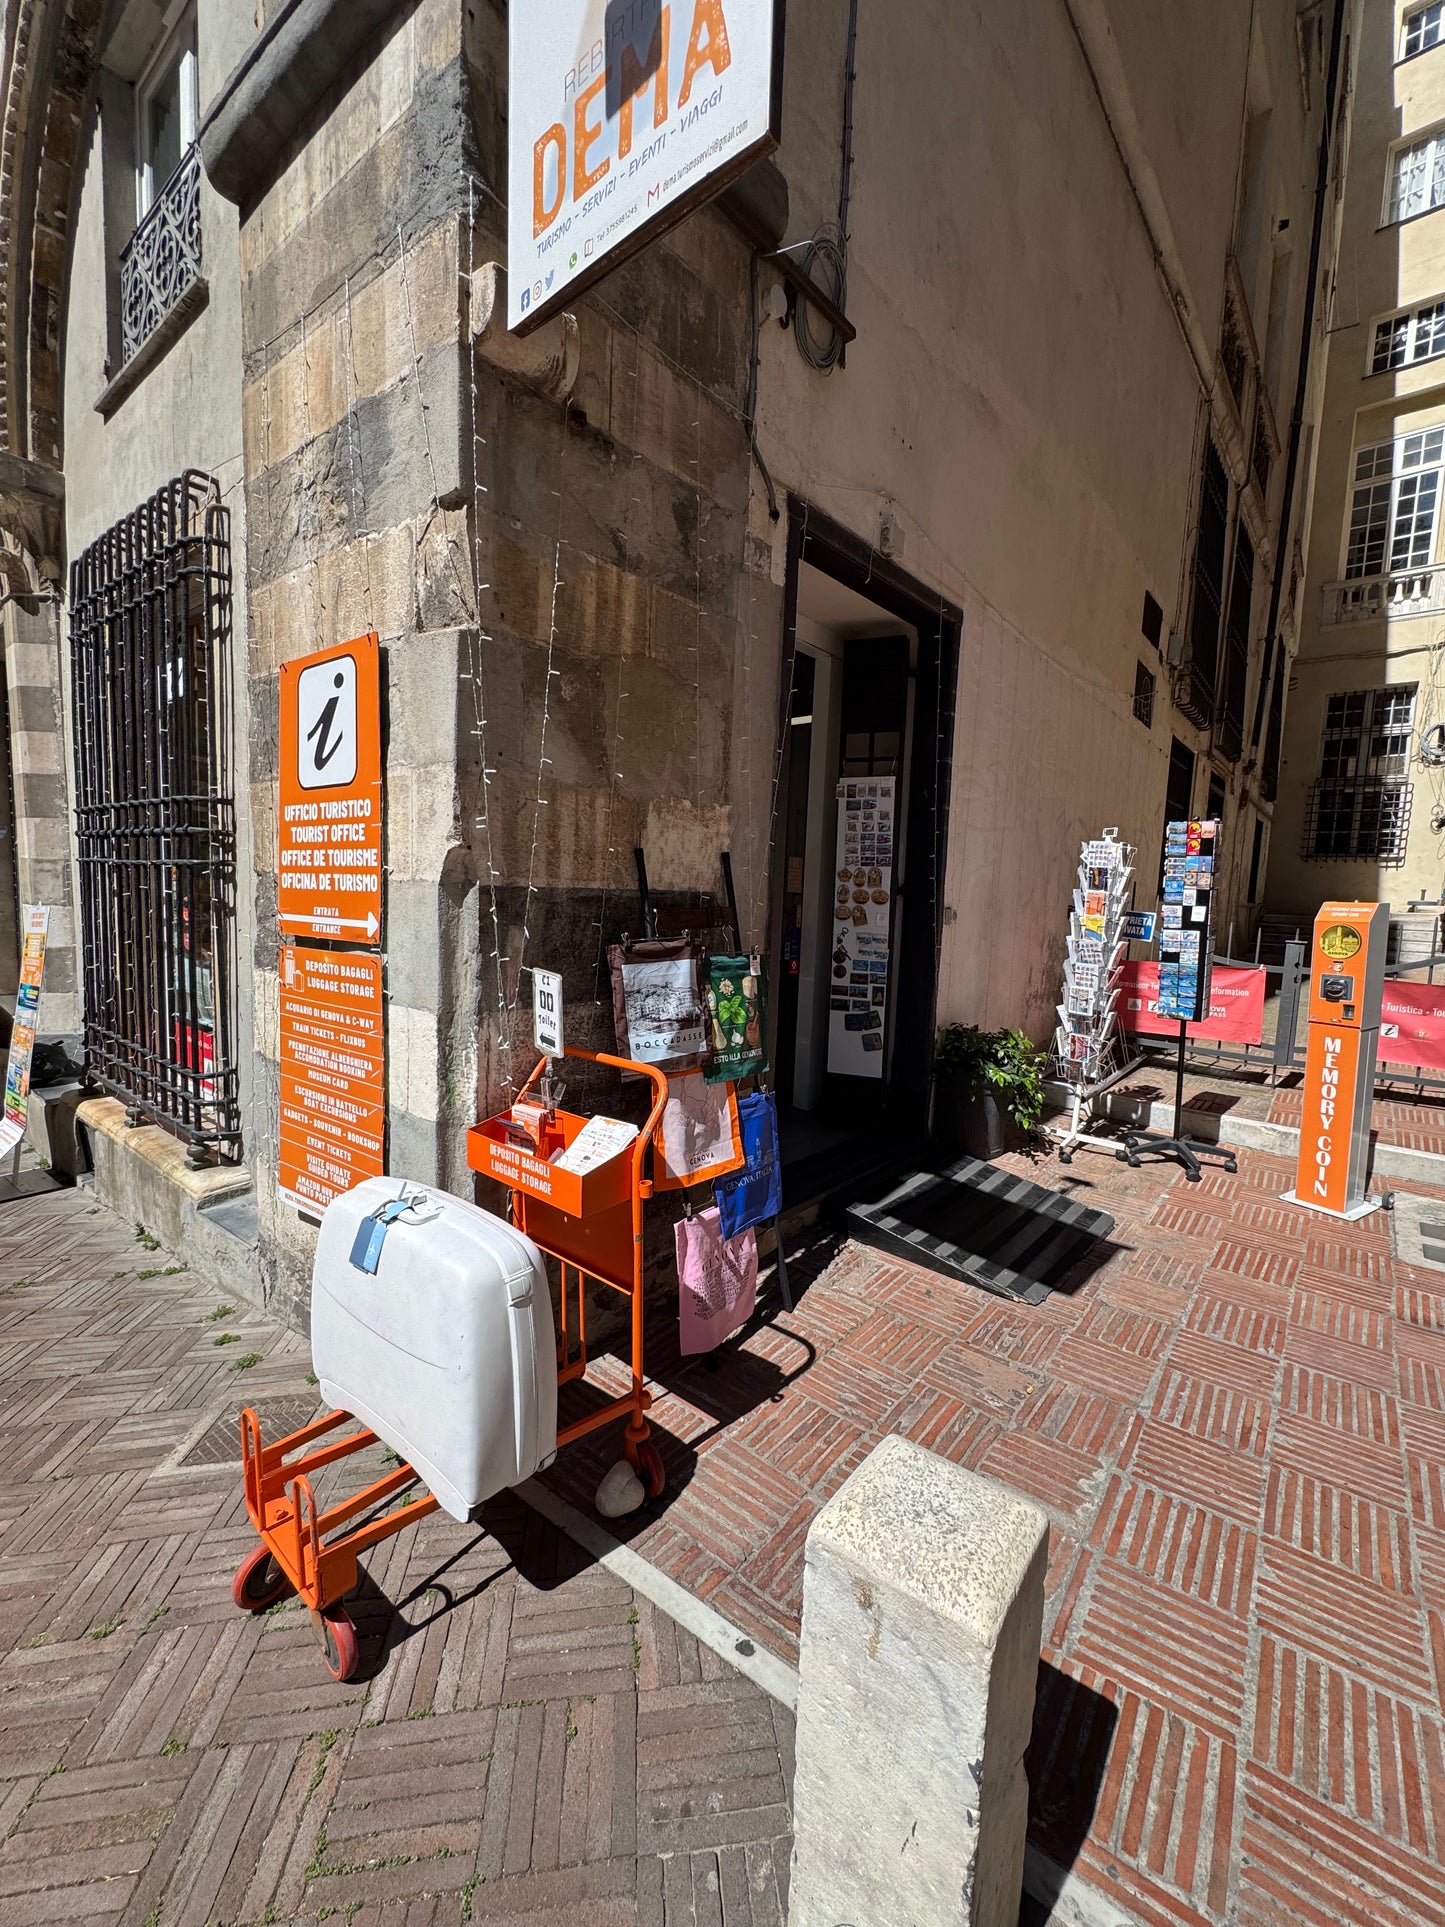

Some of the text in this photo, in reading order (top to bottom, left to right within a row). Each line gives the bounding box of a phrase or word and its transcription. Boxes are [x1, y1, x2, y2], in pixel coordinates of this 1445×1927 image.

[532, 0, 732, 241] DEMA
[536, 217, 572, 258] TURISMO
[582, 176, 617, 218] SERVIZI
[628, 133, 666, 178] EVENTI
[680, 85, 723, 133] VIAGGI
[284, 798, 372, 822] UFFICIO TURISTICO
[291, 823, 366, 843] TOURIST OFFICE
[281, 848, 379, 867] OFFICE DE TOURISME
[281, 872, 378, 893] OFICINA DE TURISMO
[313, 906, 340, 917] ENTRATA
[312, 923, 342, 935] ENTRANCE
[1123, 926, 1145, 936] IVATA
[305, 960, 374, 981] DEPOSITO BAGAGLI
[307, 976, 375, 999] LUGGAGE STORAGE
[1210, 987, 1250, 997] nformation
[285, 1001, 312, 1016] ACQUARIO
[313, 1007, 320, 1017] DI
[321, 1008, 345, 1023] GENOVA
[352, 1016, 374, 1029] C-WAY
[1386, 1002, 1423, 1015] Turistica
[538, 1014, 556, 1031] Toilet
[292, 1021, 309, 1033] TRAIN
[310, 1026, 335, 1040] TICKETS
[340, 1033, 366, 1048] FLIXBUS
[635, 1031, 703, 1051] BOCCADASSE
[288, 1039, 373, 1071] PRENOTAZIONE ALBERGHIERA
[713, 1054, 729, 1064] ESTO
[307, 1069, 349, 1090] MUSEUM CARD
[339, 1062, 366, 1079] BOOKING
[1318, 1036, 1342, 1131] MEMORY
[294, 1085, 368, 1118] ESCURSIONI IN BATTELLO
[303, 1097, 357, 1124] BOAT EXCURSIONS
[283, 1107, 308, 1124] GADGETS
[313, 1118, 342, 1138] SOUVENIR
[347, 1131, 380, 1152] BOOKSHOP
[307, 1136, 352, 1162] EVENT TICKETS
[489, 1143, 550, 1178] DEPOSITO BAGAGLI
[689, 1152, 715, 1165] GENOVA
[306, 1153, 352, 1180] VISITE GUIDATE
[307, 1163, 349, 1189] GUIDED TOURS
[491, 1159, 552, 1196] LUGGAGE STORAGE
[1313, 1135, 1332, 1198] COIN
[295, 1182, 314, 1199] PUNTO
[314, 1189, 332, 1205] POST
[297, 1175, 320, 1193] AMAZON
